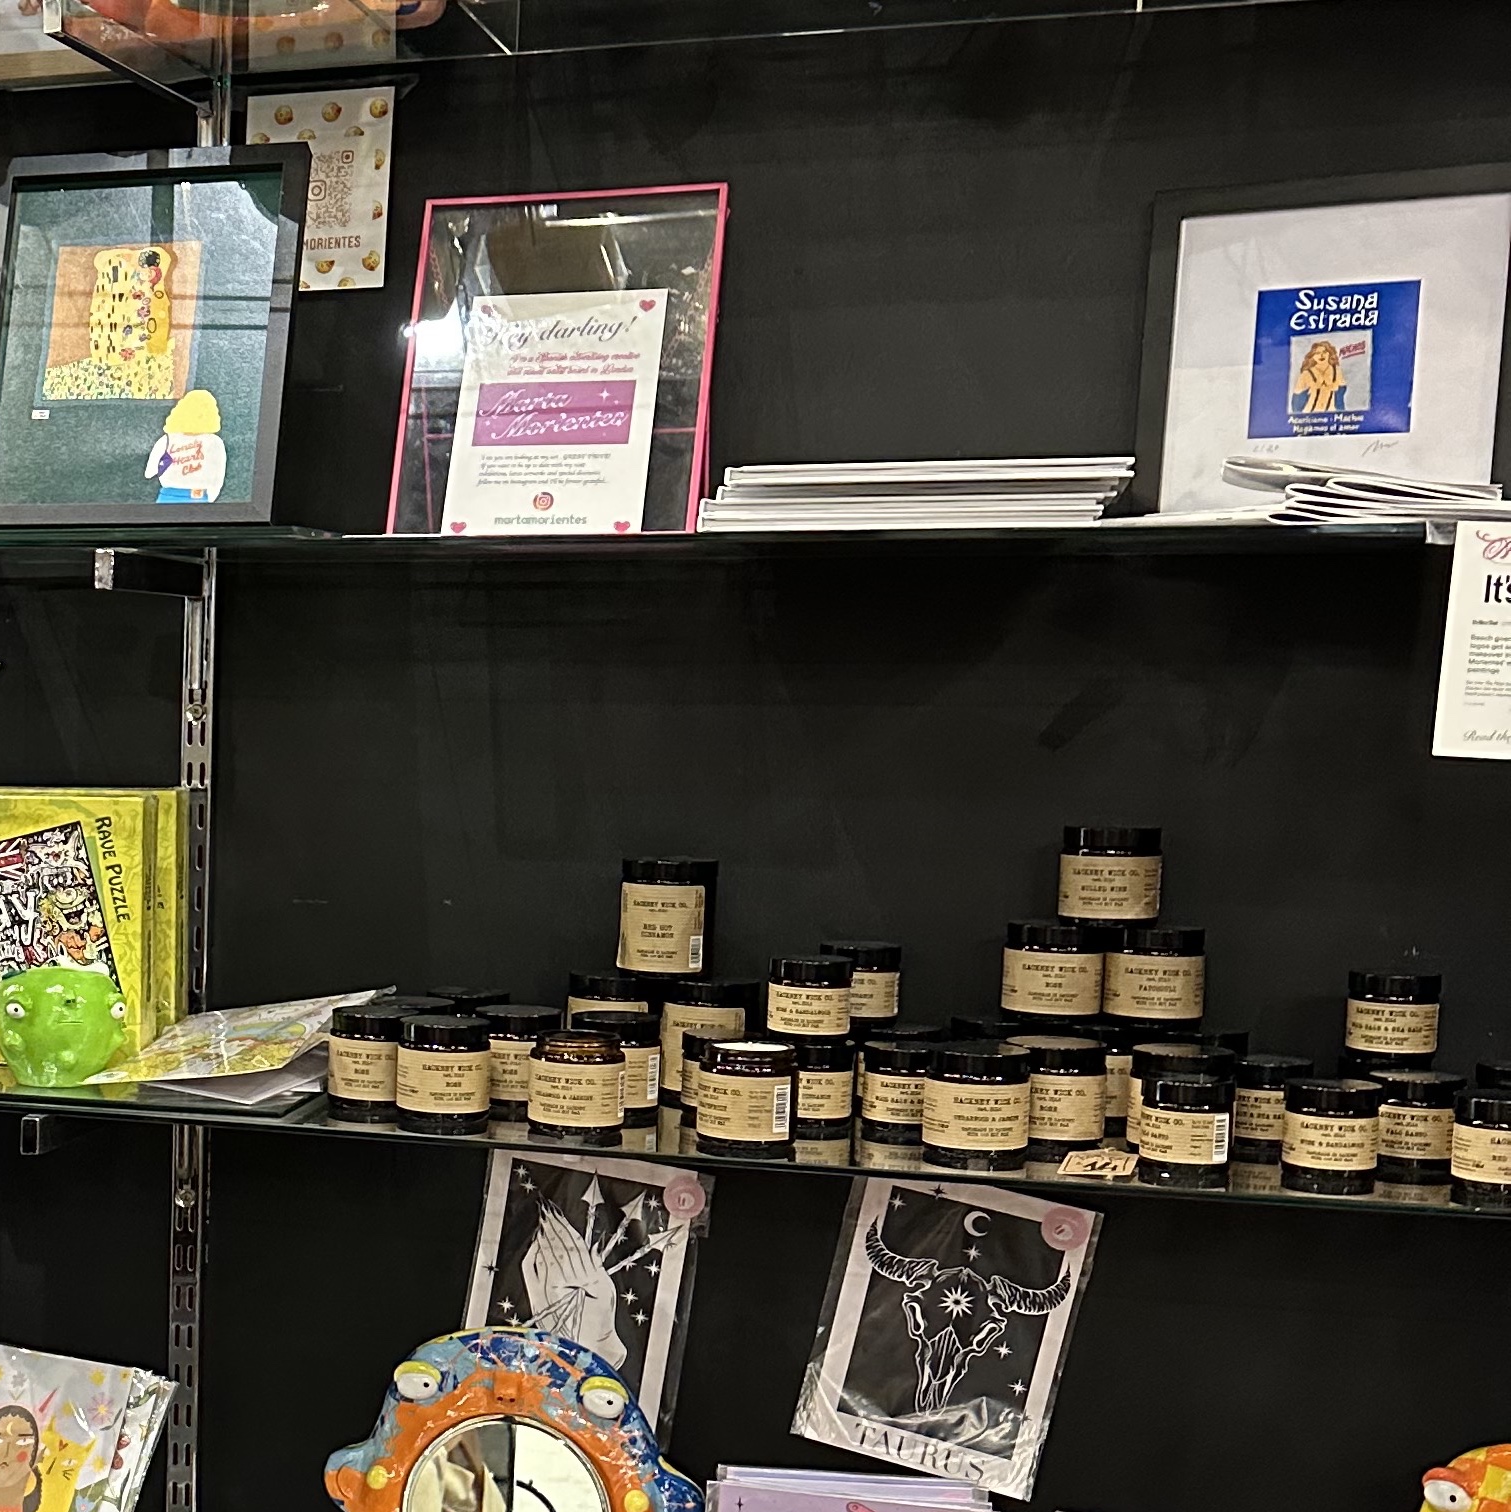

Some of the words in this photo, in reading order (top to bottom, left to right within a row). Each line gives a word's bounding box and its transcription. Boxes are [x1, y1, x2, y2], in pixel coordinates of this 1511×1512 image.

[1295, 289, 1378, 311] Susana
[539, 315, 638, 342] darling!
[1290, 310, 1379, 331] Estrada
[479, 388, 573, 419] Marta
[491, 410, 630, 440] Morientes
[169, 439, 203, 454] Lonely
[172, 452, 205, 466] Hearts
[182, 463, 203, 476] Club
[494, 514, 587, 525] martamorientes
[1463, 728, 1496, 742] Read
[95, 816, 117, 860] RAVE
[105, 863, 131, 924] PUZZLE
[855, 1422, 986, 1485] TAURUS
